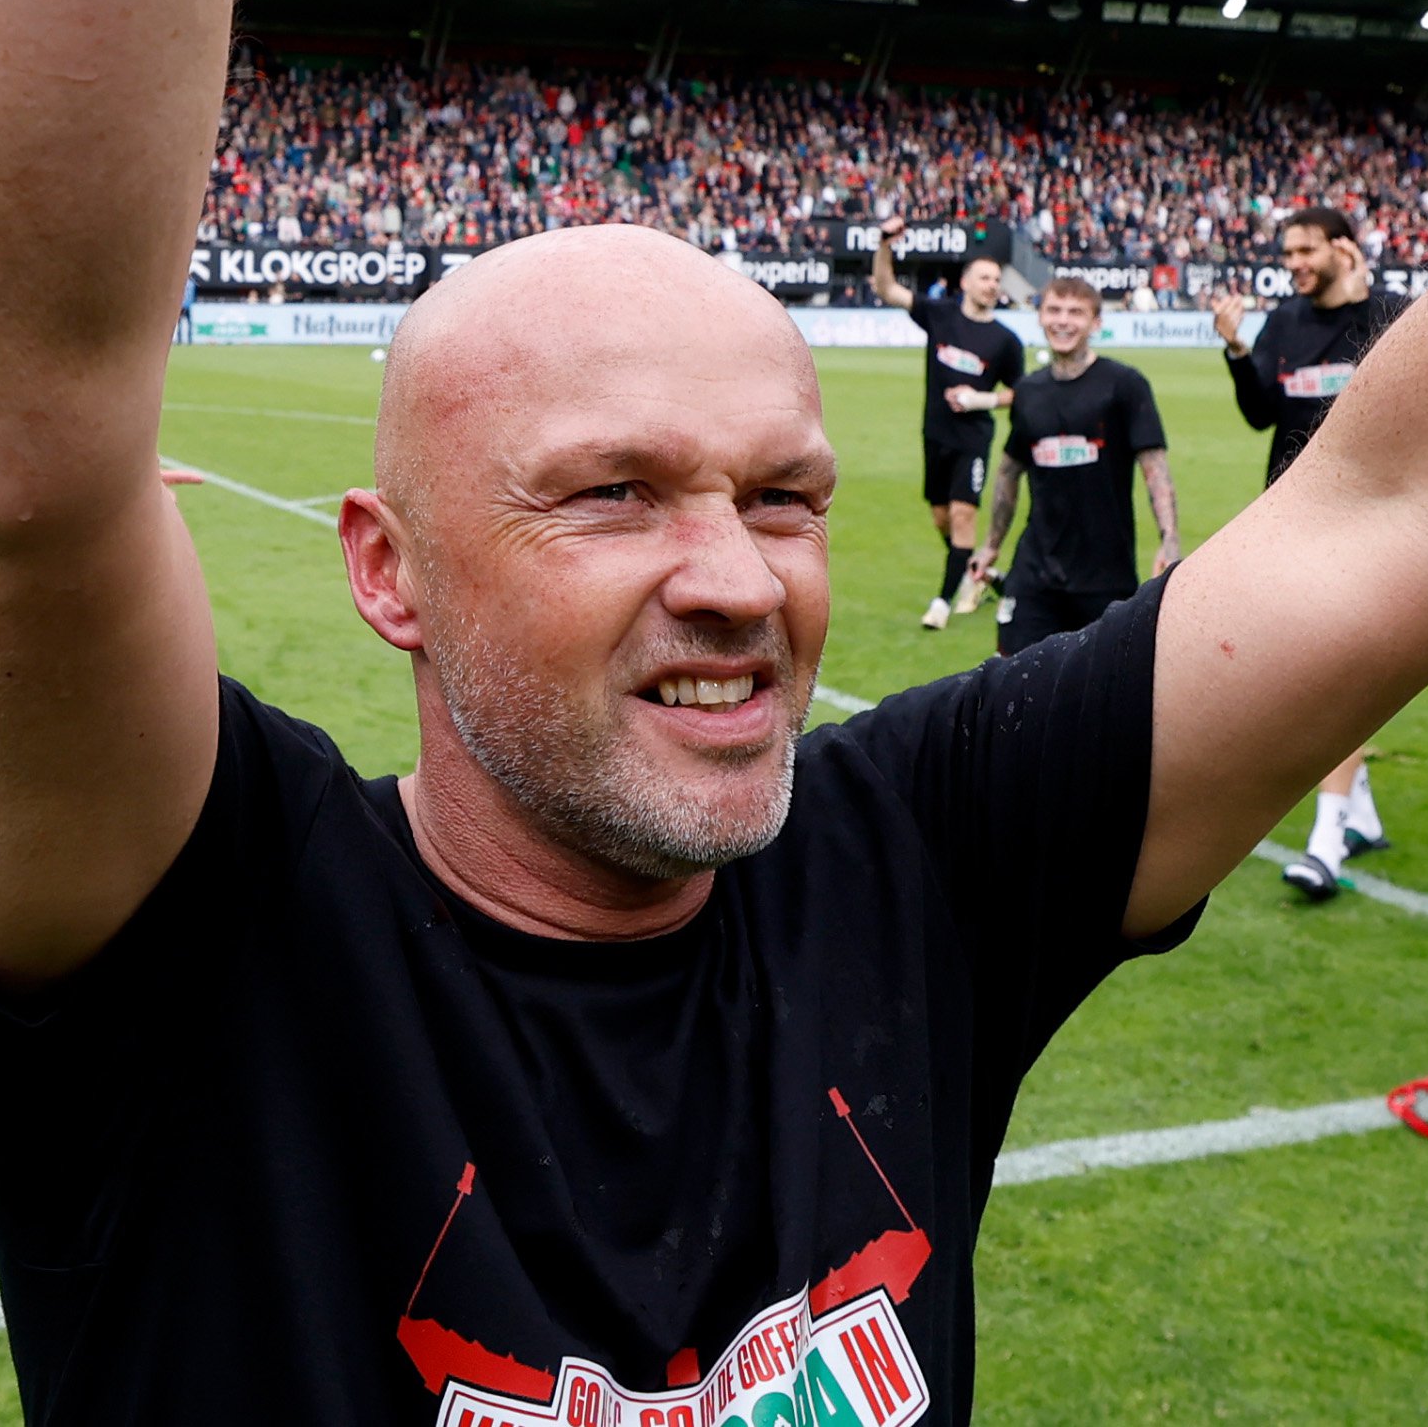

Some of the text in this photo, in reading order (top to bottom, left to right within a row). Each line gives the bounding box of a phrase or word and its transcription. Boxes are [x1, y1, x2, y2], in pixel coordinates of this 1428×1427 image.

[219, 249, 427, 285] KLOKGROEP
[740, 257, 831, 290] experia
[839, 1316, 912, 1427] IN
[567, 1376, 601, 1427] GO
